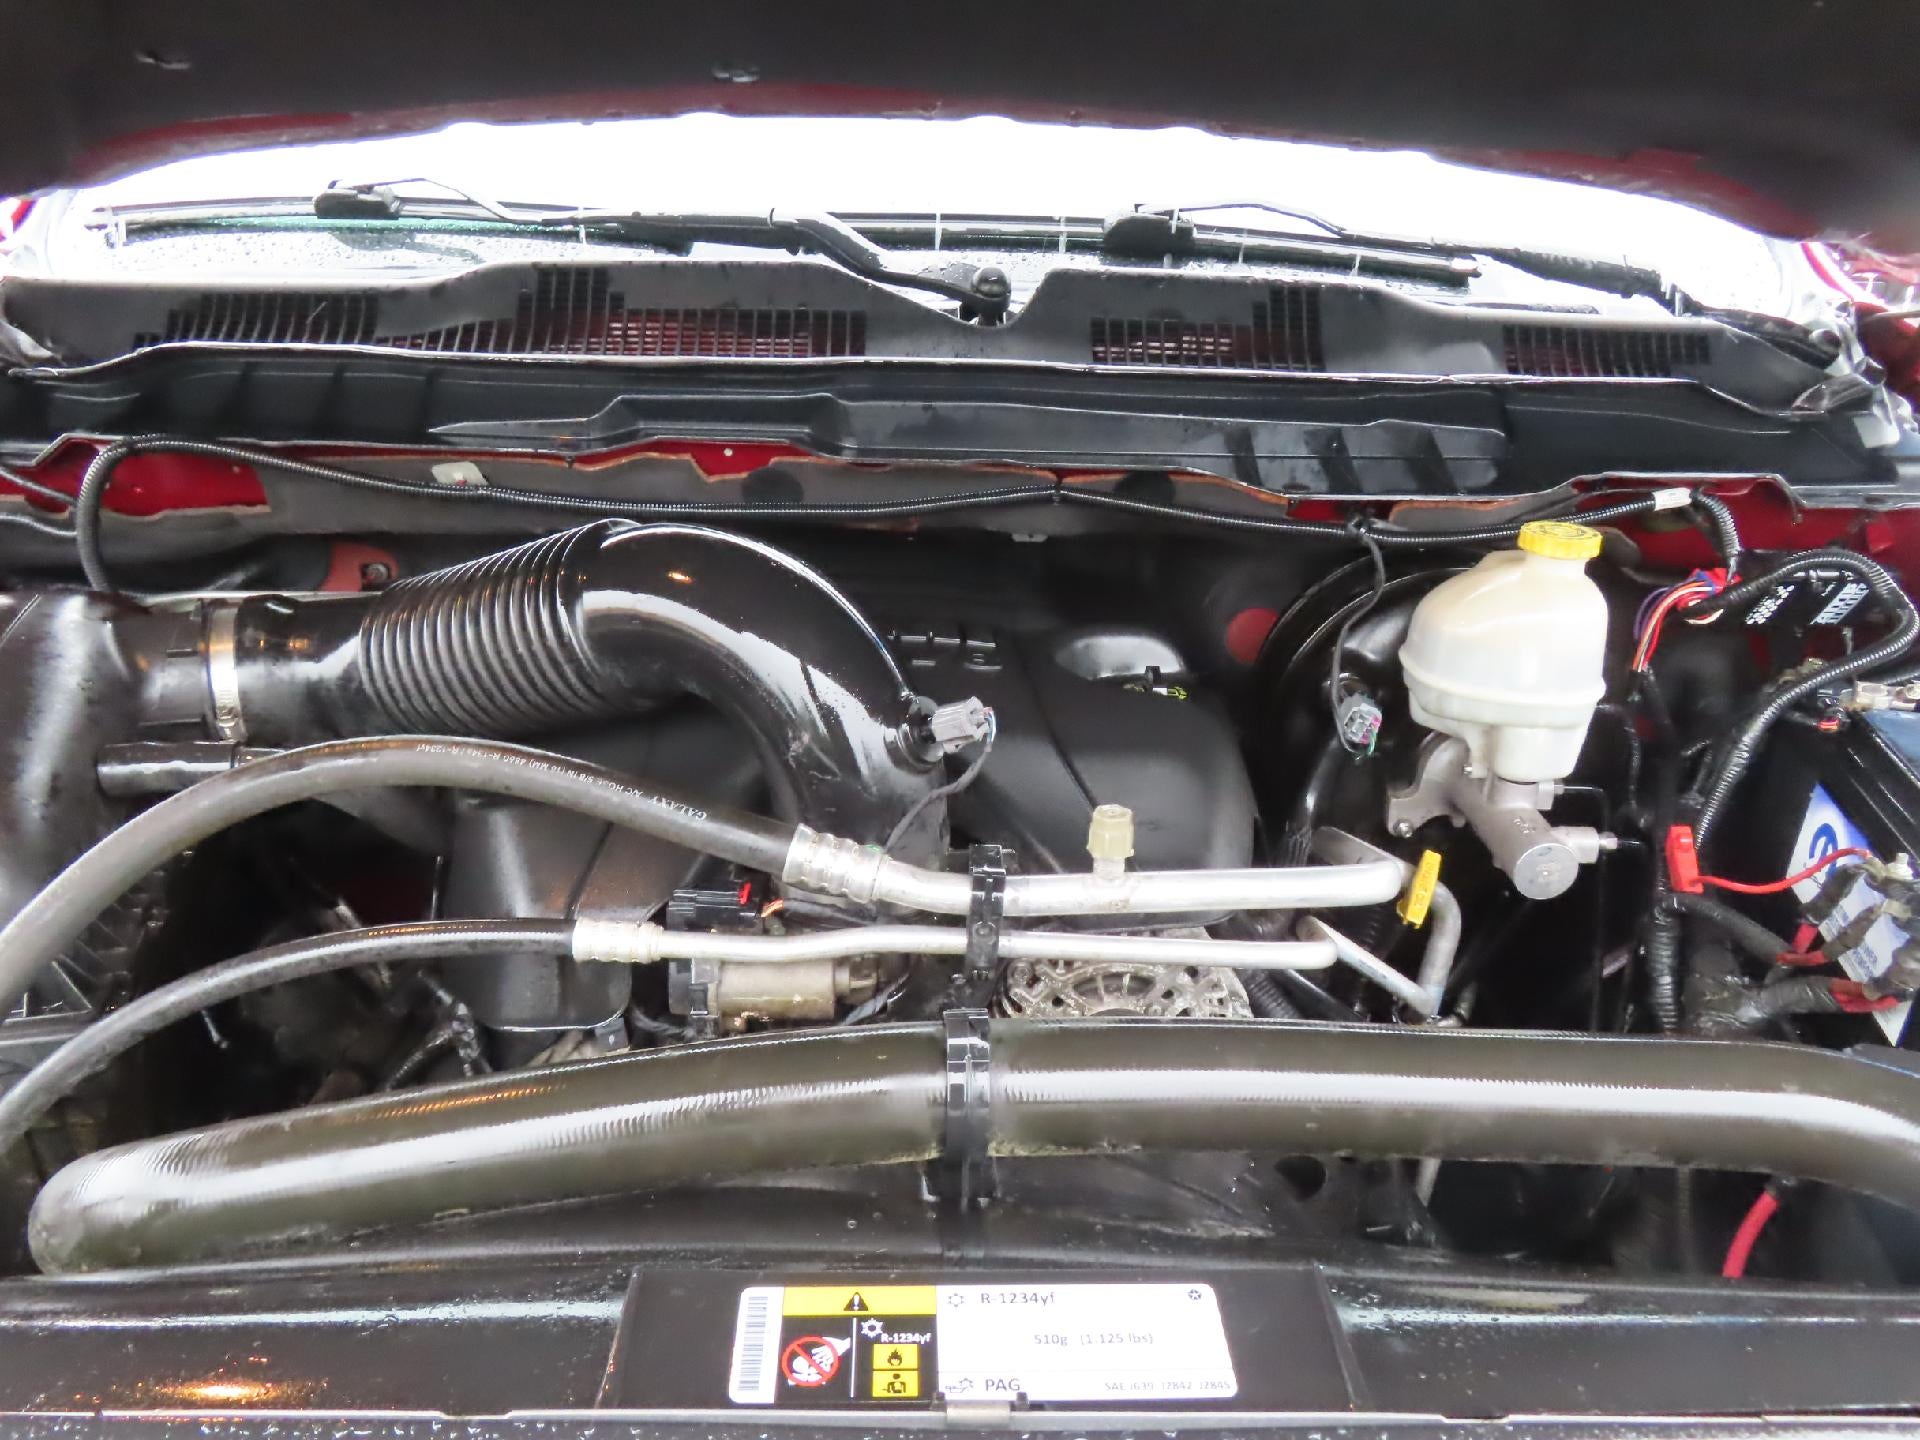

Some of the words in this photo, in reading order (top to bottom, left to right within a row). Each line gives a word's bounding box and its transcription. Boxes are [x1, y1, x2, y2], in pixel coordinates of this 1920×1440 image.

[648, 795, 708, 821] GALAXY
[981, 1291, 1055, 1306] R-1234yf
[880, 1332, 932, 1345] R-1234yf
[1033, 1334, 1068, 1347] 510g
[1129, 1333, 1154, 1345] lbs)
[984, 1378, 1021, 1392] PAG
[1104, 1381, 1126, 1391] SAE
